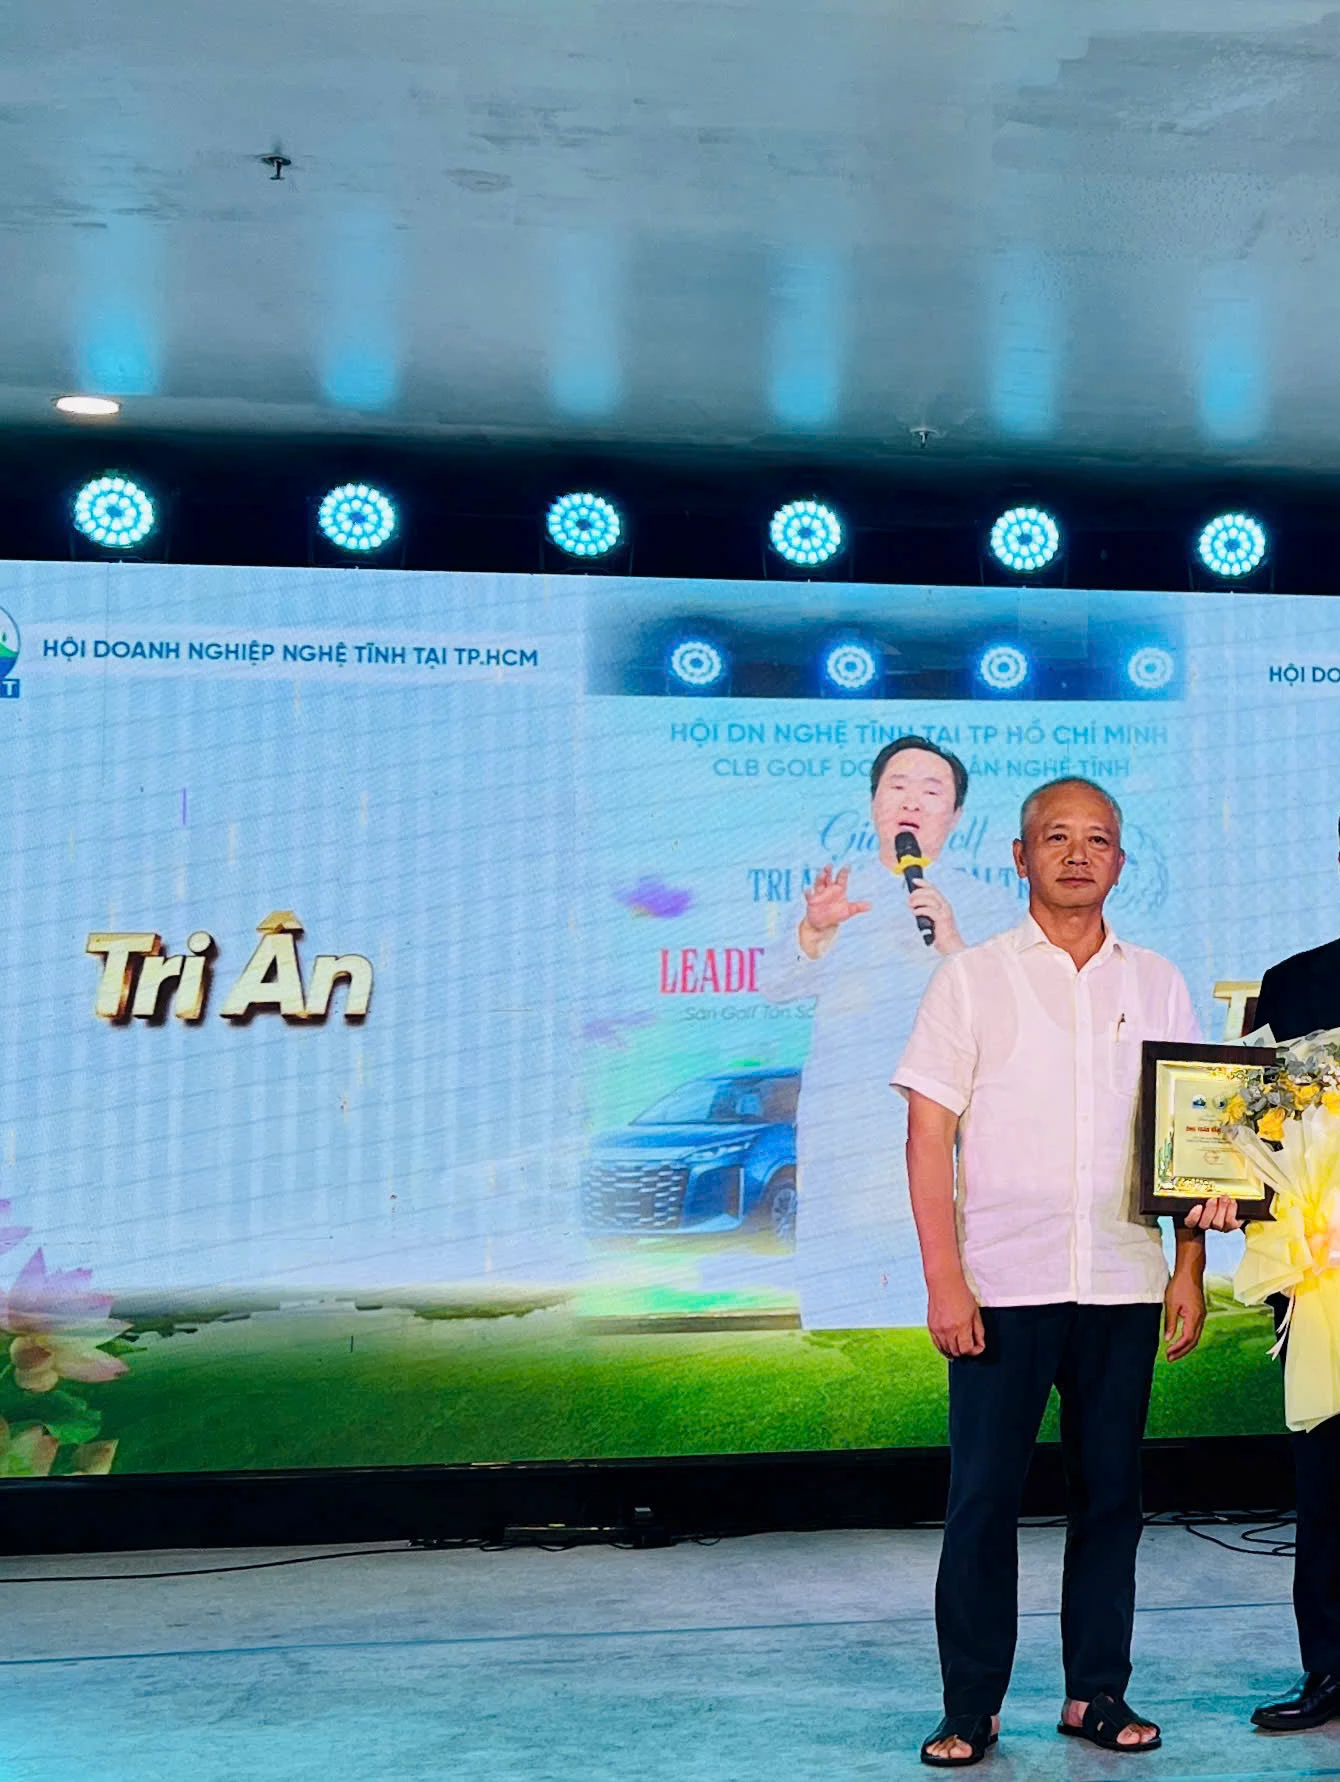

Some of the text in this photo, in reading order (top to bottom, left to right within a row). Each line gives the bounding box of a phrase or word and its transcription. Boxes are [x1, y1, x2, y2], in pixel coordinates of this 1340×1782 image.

[43, 636, 539, 670] HỘI DOANH NGHIỆP NGHỆ TĨNH TẠI TP.HCM
[1269, 664, 1305, 687] HỘI
[671, 718, 719, 748] HỘI
[727, 724, 765, 744] DN
[966, 726, 999, 744] TP
[1103, 727, 1169, 745] MINH
[712, 758, 761, 777] CLB
[766, 758, 831, 777] GOLF
[86, 910, 375, 1022] Tri Ân
